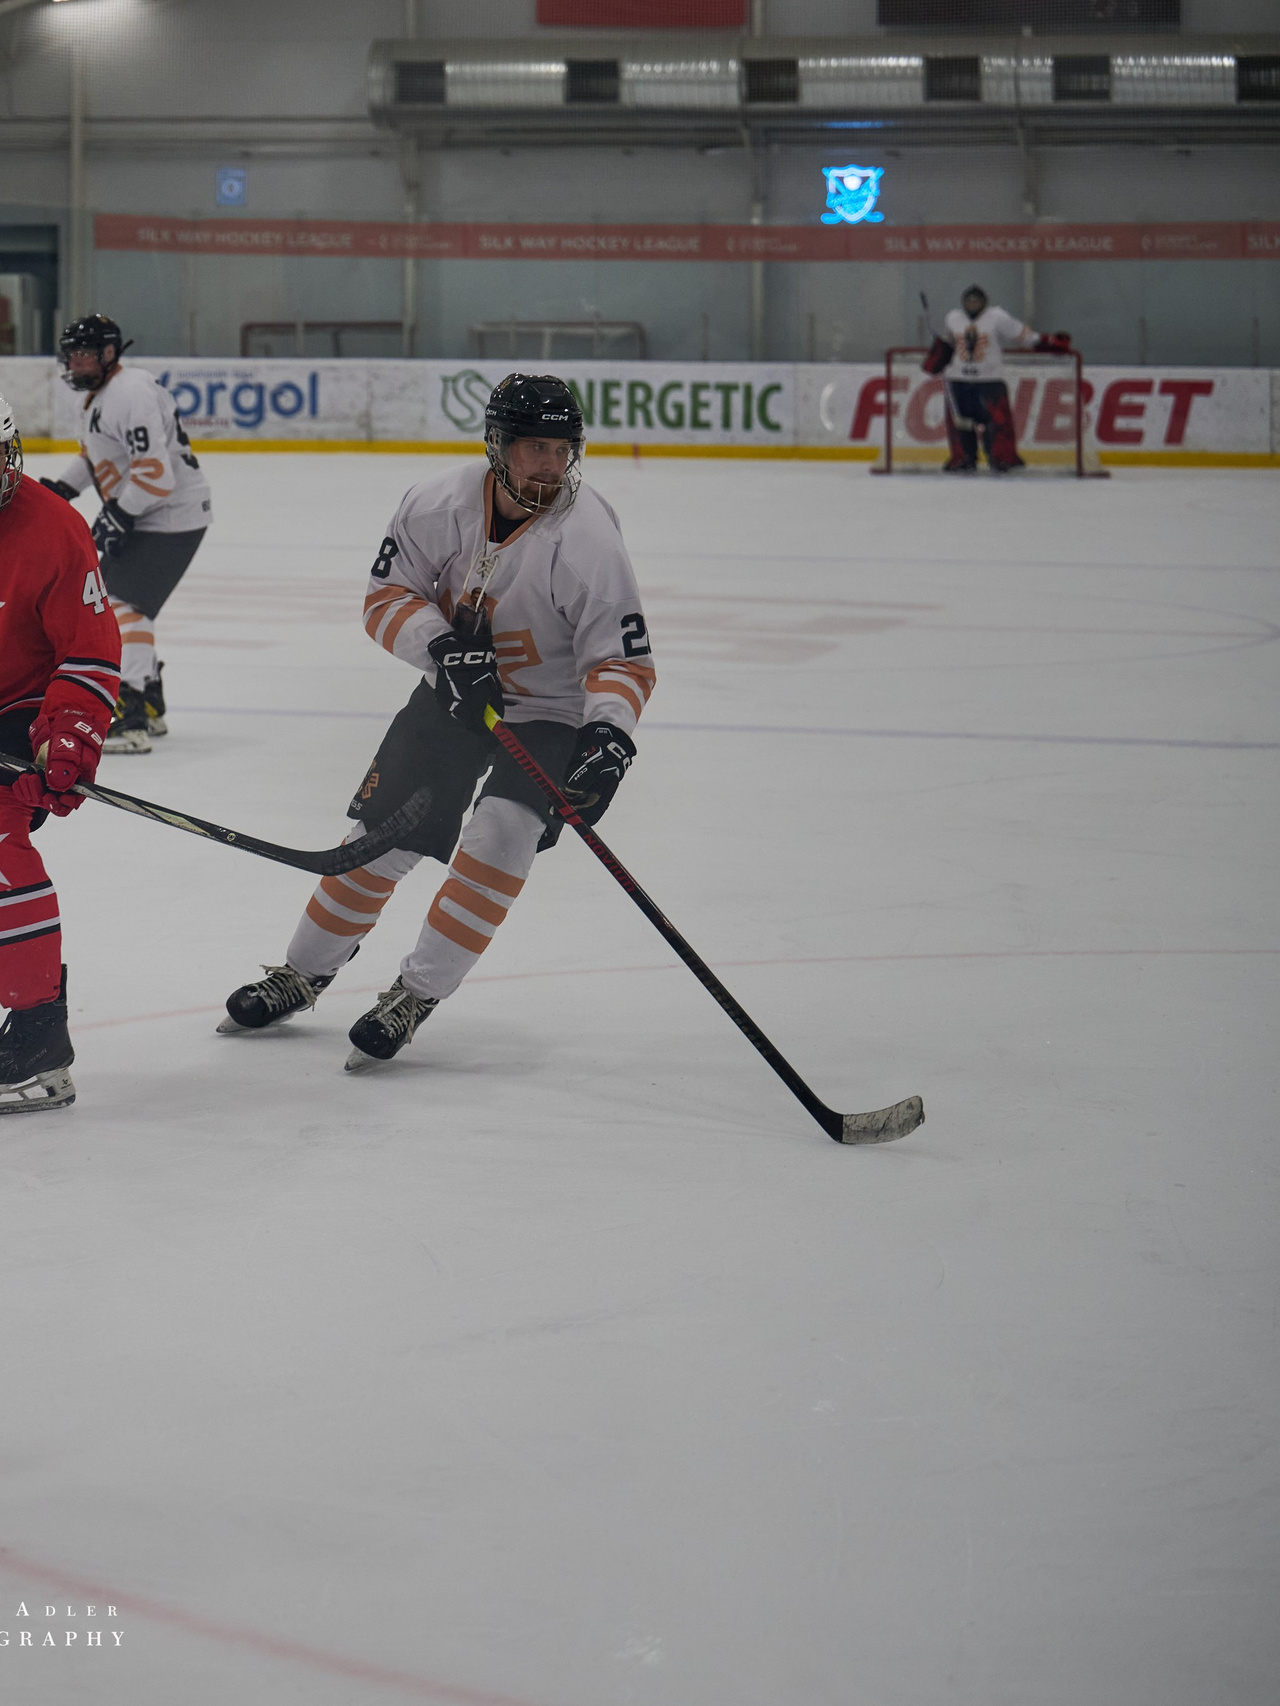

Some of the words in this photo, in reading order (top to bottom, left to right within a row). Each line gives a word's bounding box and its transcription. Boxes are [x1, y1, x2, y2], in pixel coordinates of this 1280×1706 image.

[479, 234, 513, 250] SILK
[519, 235, 558, 250] WAY
[561, 235, 632, 251] HOCKEY
[884, 236, 920, 252] SILK
[925, 236, 965, 251] WAY
[969, 236, 1040, 251] HOCKEY
[1044, 236, 1114, 251] LEAGUE
[160, 371, 318, 429] orgol
[541, 413, 569, 421] CCM
[620, 612, 653, 658] 2
[442, 650, 497, 667] CCM
[582, 832, 636, 893] NOVIUM
